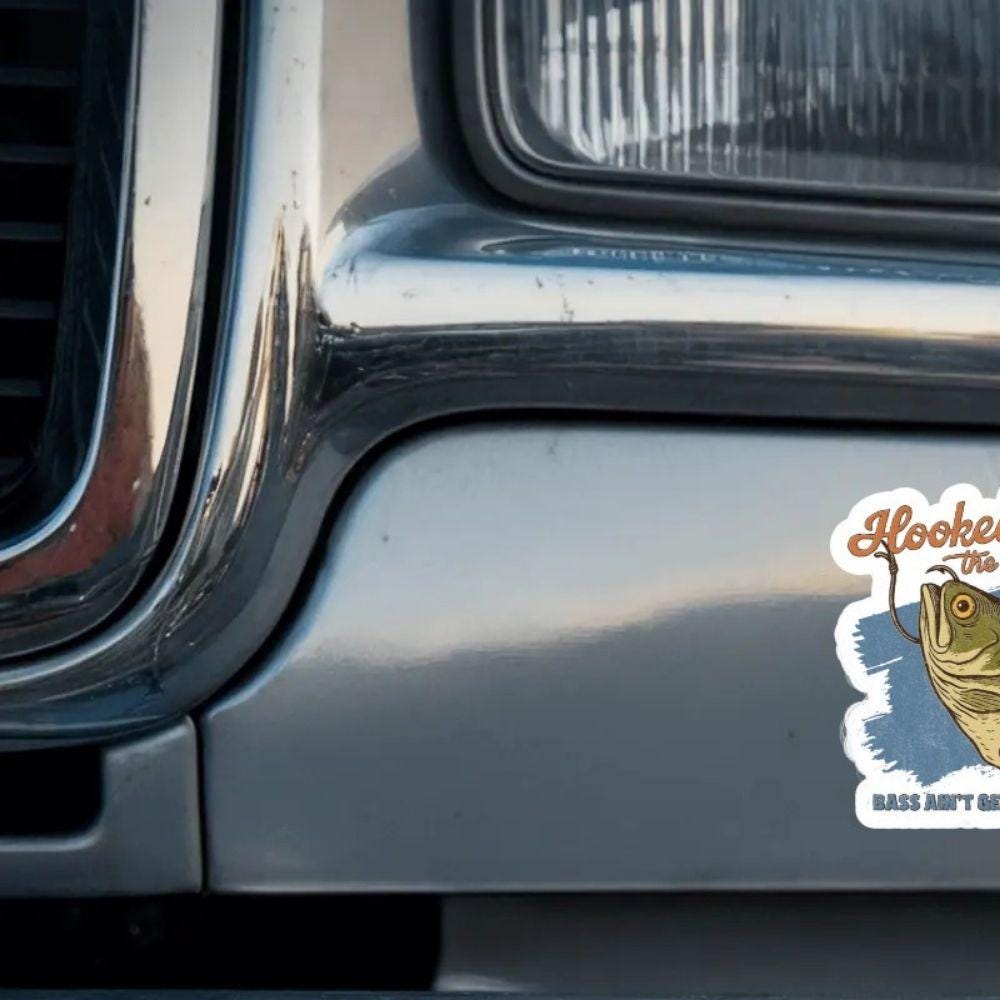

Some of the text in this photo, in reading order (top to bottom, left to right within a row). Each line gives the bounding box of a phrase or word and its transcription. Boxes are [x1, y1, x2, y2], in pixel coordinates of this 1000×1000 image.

[942, 549, 999, 575] the
[872, 793, 920, 811] BASS
[924, 793, 974, 811] AIN'T
